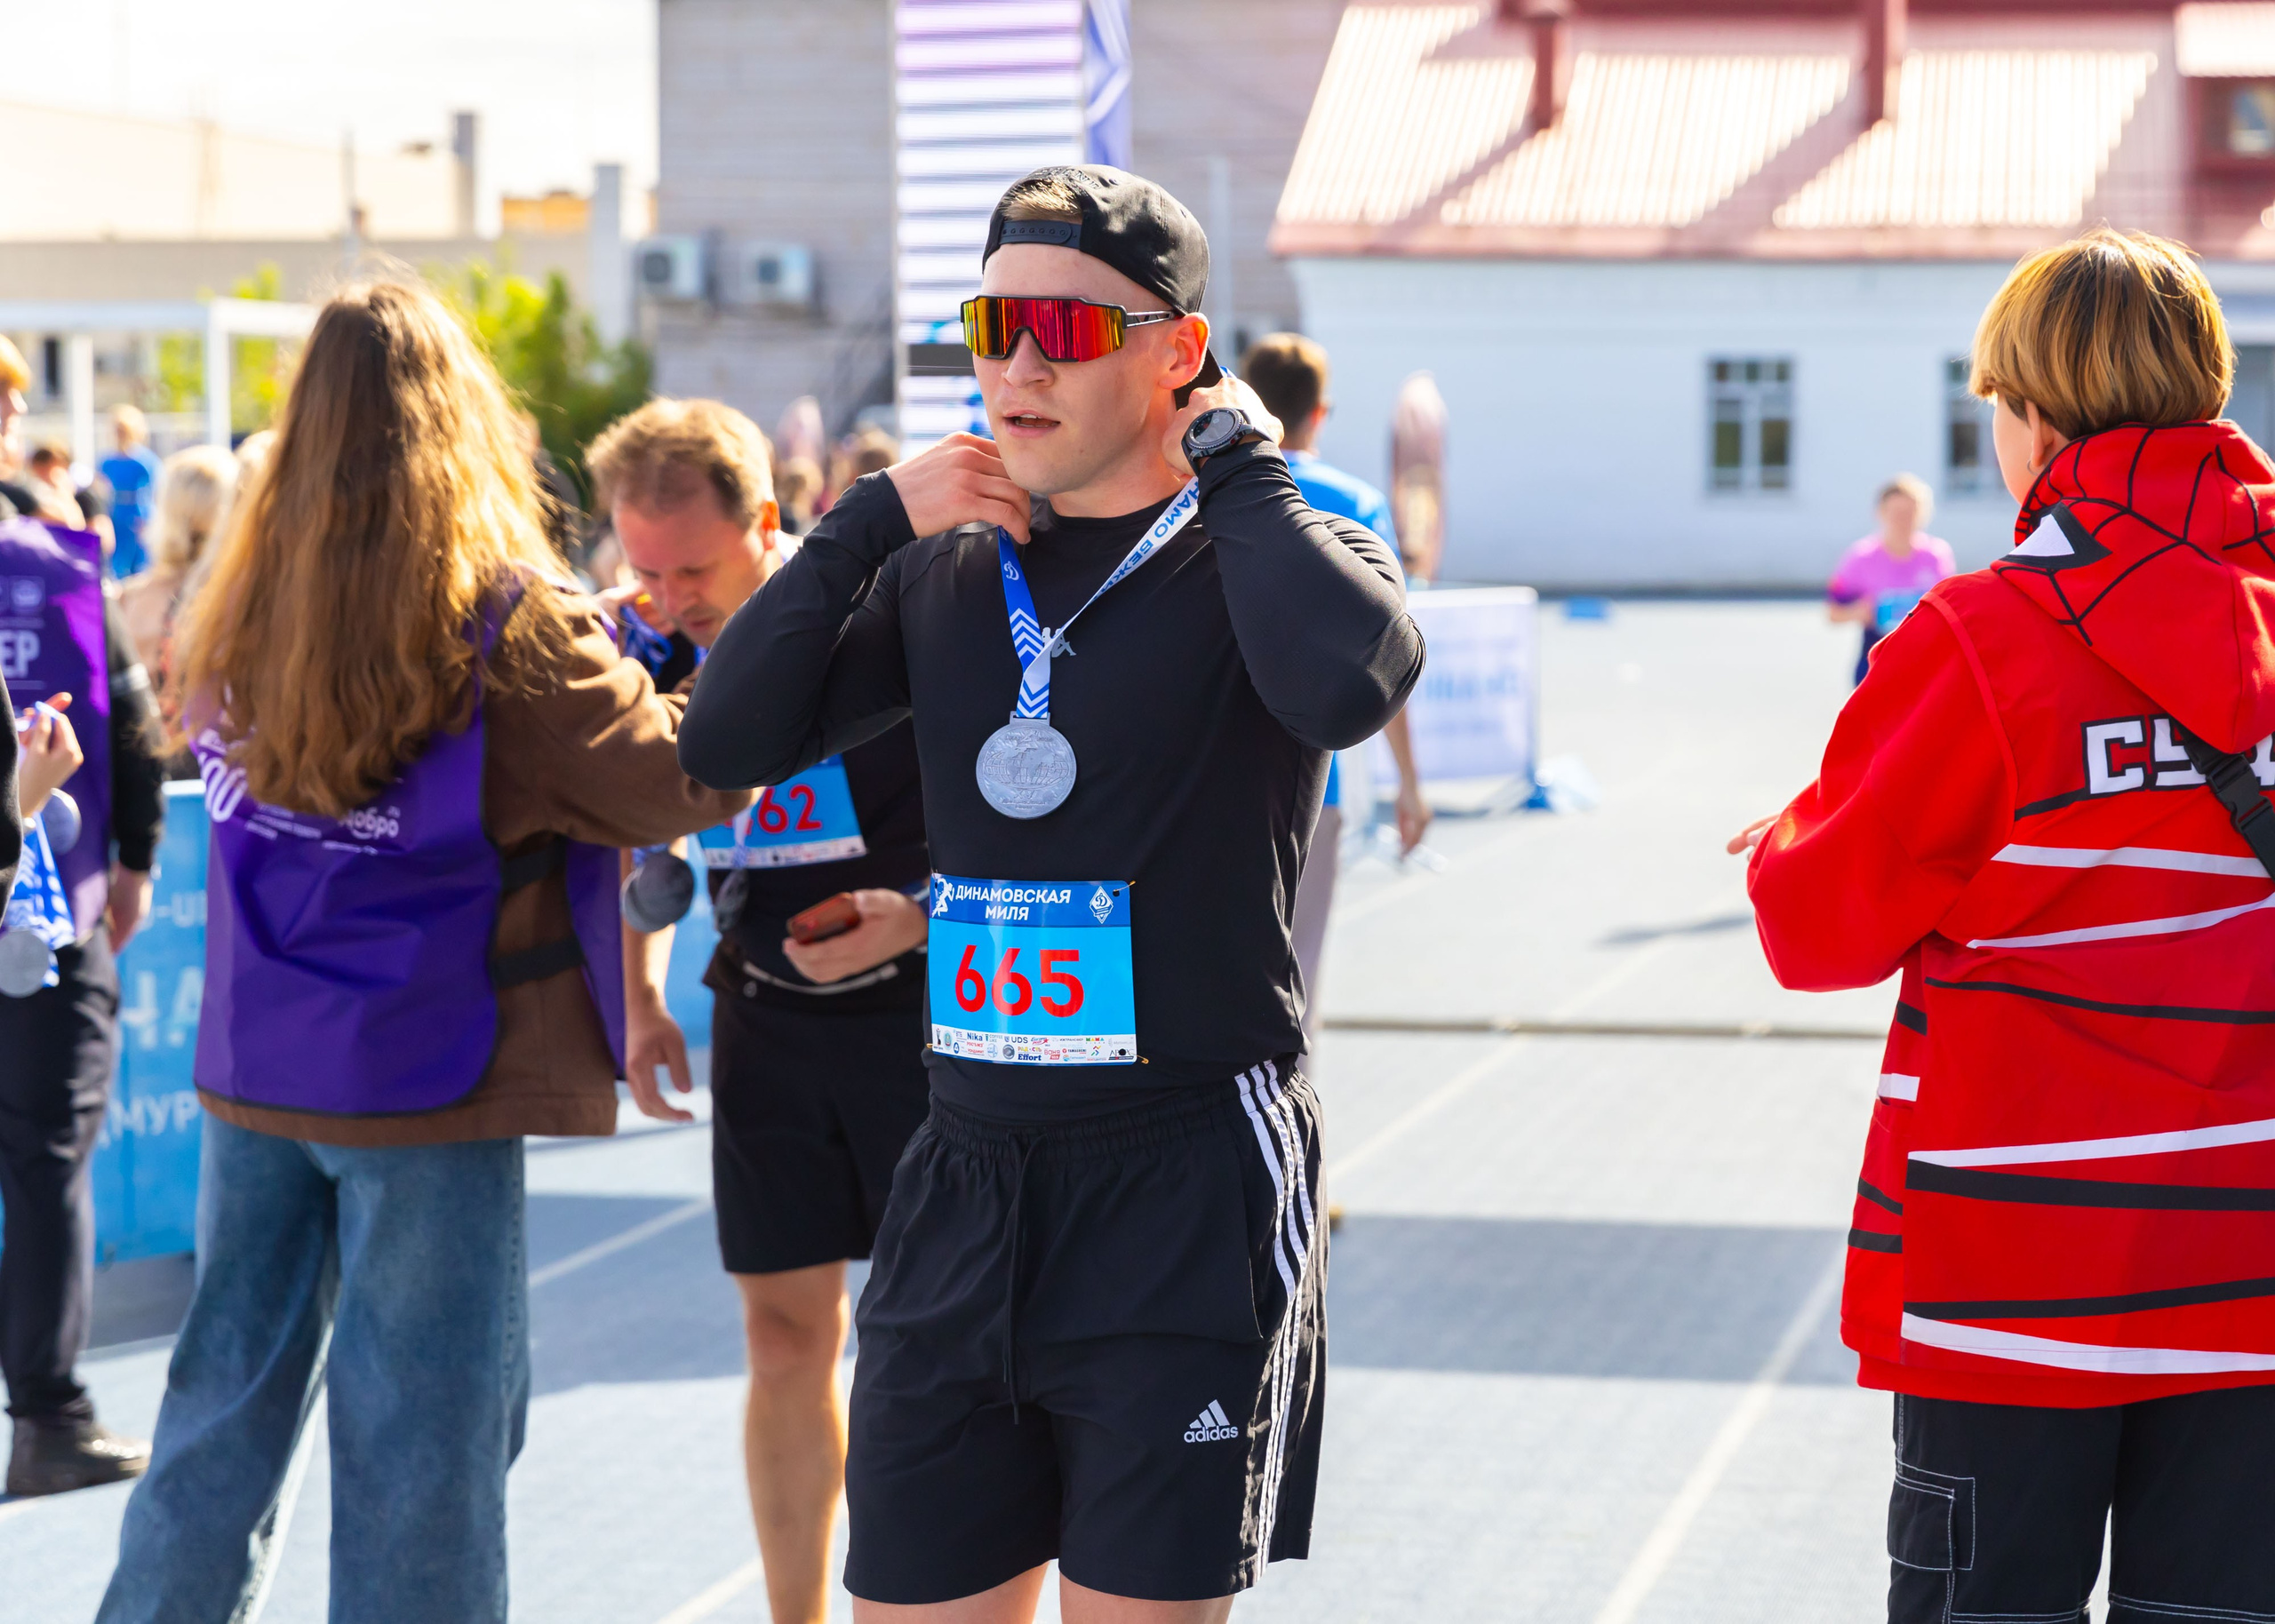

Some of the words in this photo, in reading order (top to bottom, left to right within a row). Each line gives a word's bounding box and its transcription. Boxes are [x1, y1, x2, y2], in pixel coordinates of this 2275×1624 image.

[724, 783, 823, 835] 62
[955, 885, 1072, 904] ДИНАМОВСКАЯ
[985, 904, 1029, 921] МИЛЯ
[954, 943, 1085, 1018] 665
[967, 1032, 983, 1041] Nika
[1184, 1425, 1239, 1444] adidas
